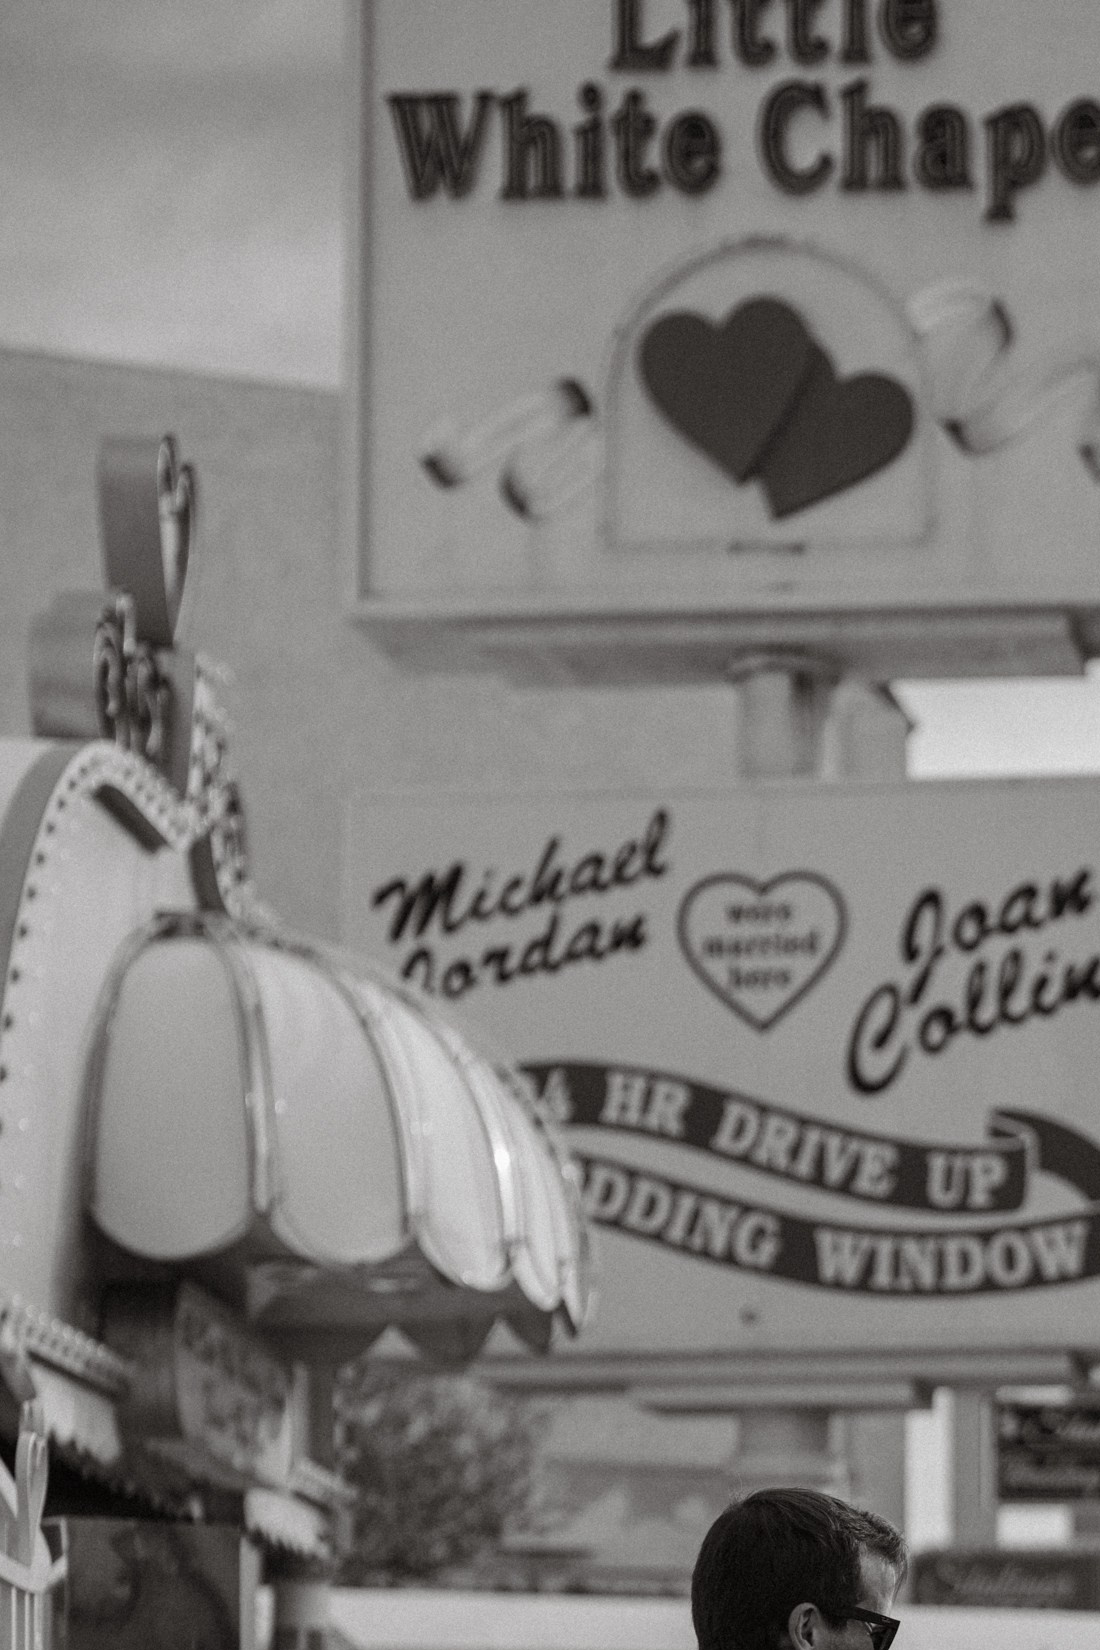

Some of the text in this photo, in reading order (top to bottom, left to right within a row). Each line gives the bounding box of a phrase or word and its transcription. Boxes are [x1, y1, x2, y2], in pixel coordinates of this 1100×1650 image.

[608, 0, 938, 72] Little
[386, 80, 722, 202] White
[371, 806, 670, 944] Michael
[903, 868, 1093, 1006] Joan
[703, 930, 819, 957] married
[600, 1071, 691, 1137] HR
[709, 1100, 899, 1198] DRIVE
[926, 1152, 1009, 1208] UP
[584, 1164, 1092, 1292] DDING WINDOW
